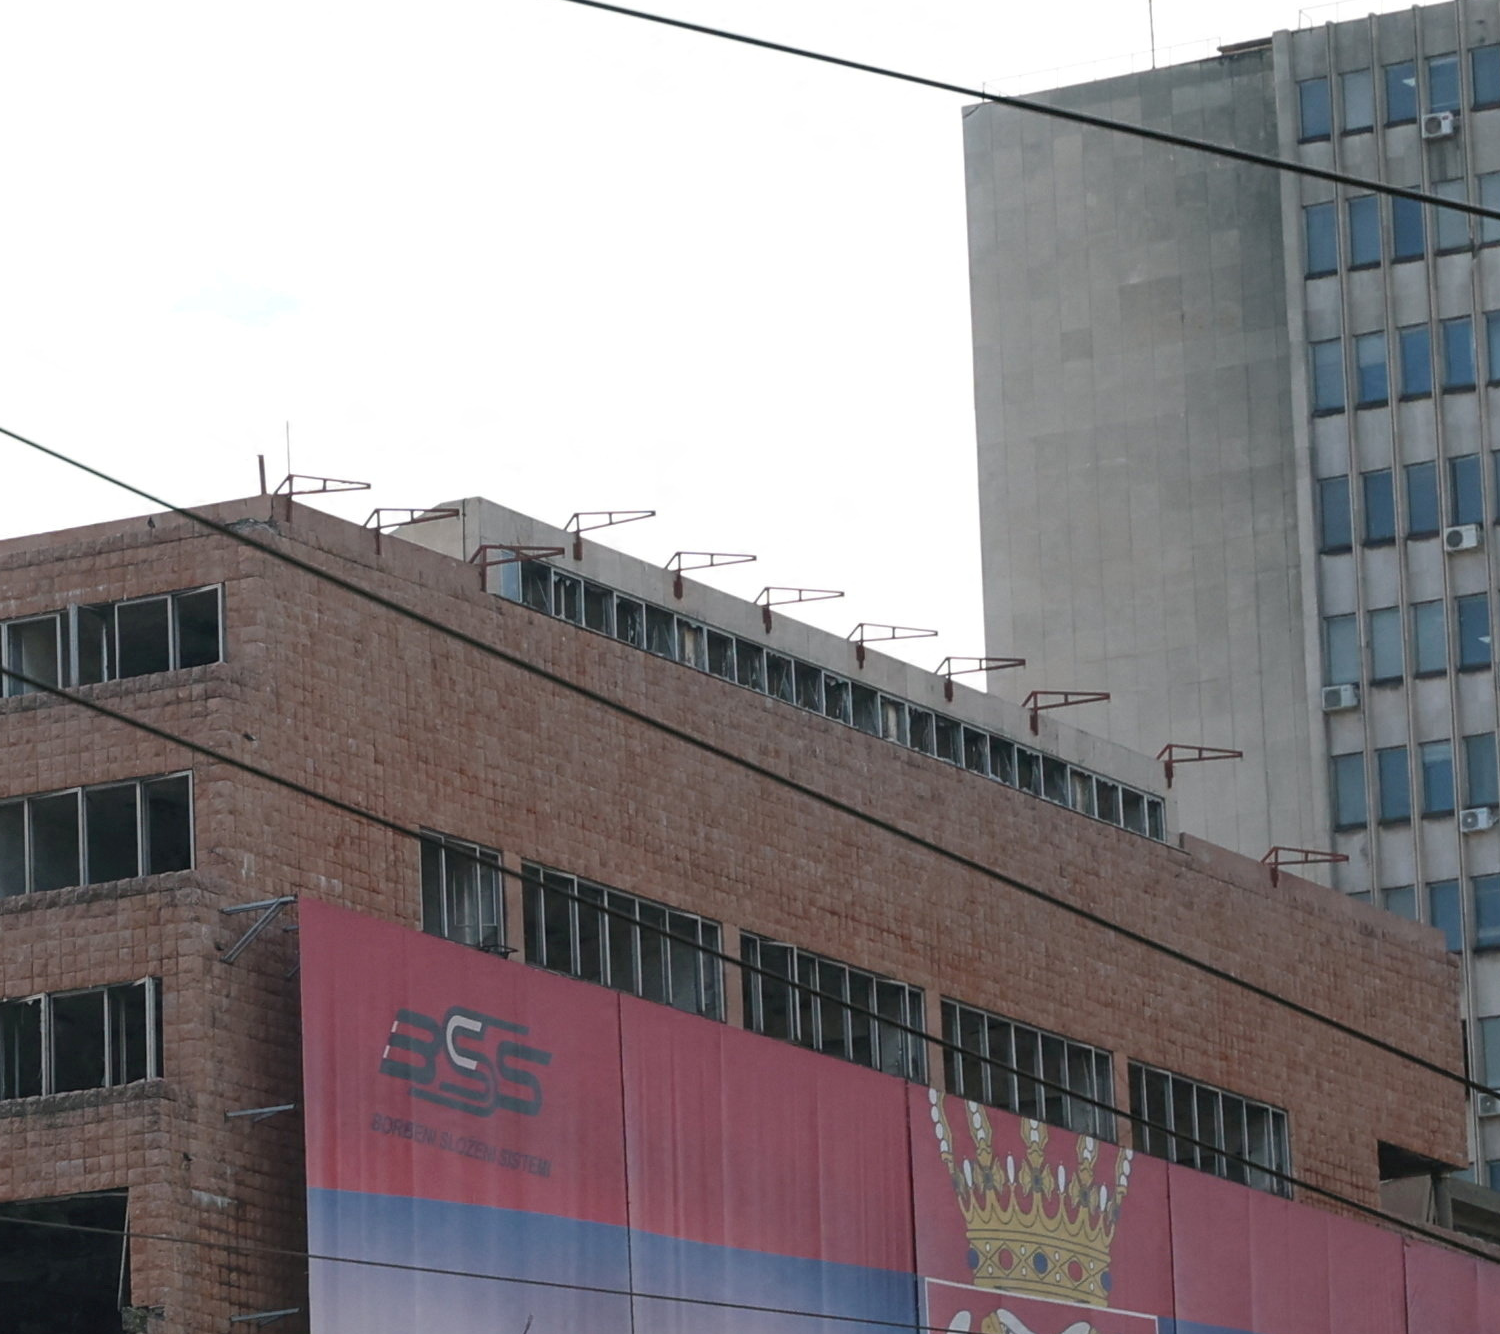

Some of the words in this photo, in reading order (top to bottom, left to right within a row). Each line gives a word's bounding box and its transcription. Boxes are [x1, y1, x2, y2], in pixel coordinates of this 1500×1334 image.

[378, 1005, 553, 1118] BSS
[370, 1112, 437, 1147] BORBENI
[439, 1131, 497, 1163] SLOŽENI
[498, 1148, 552, 1178] SISTEMI
